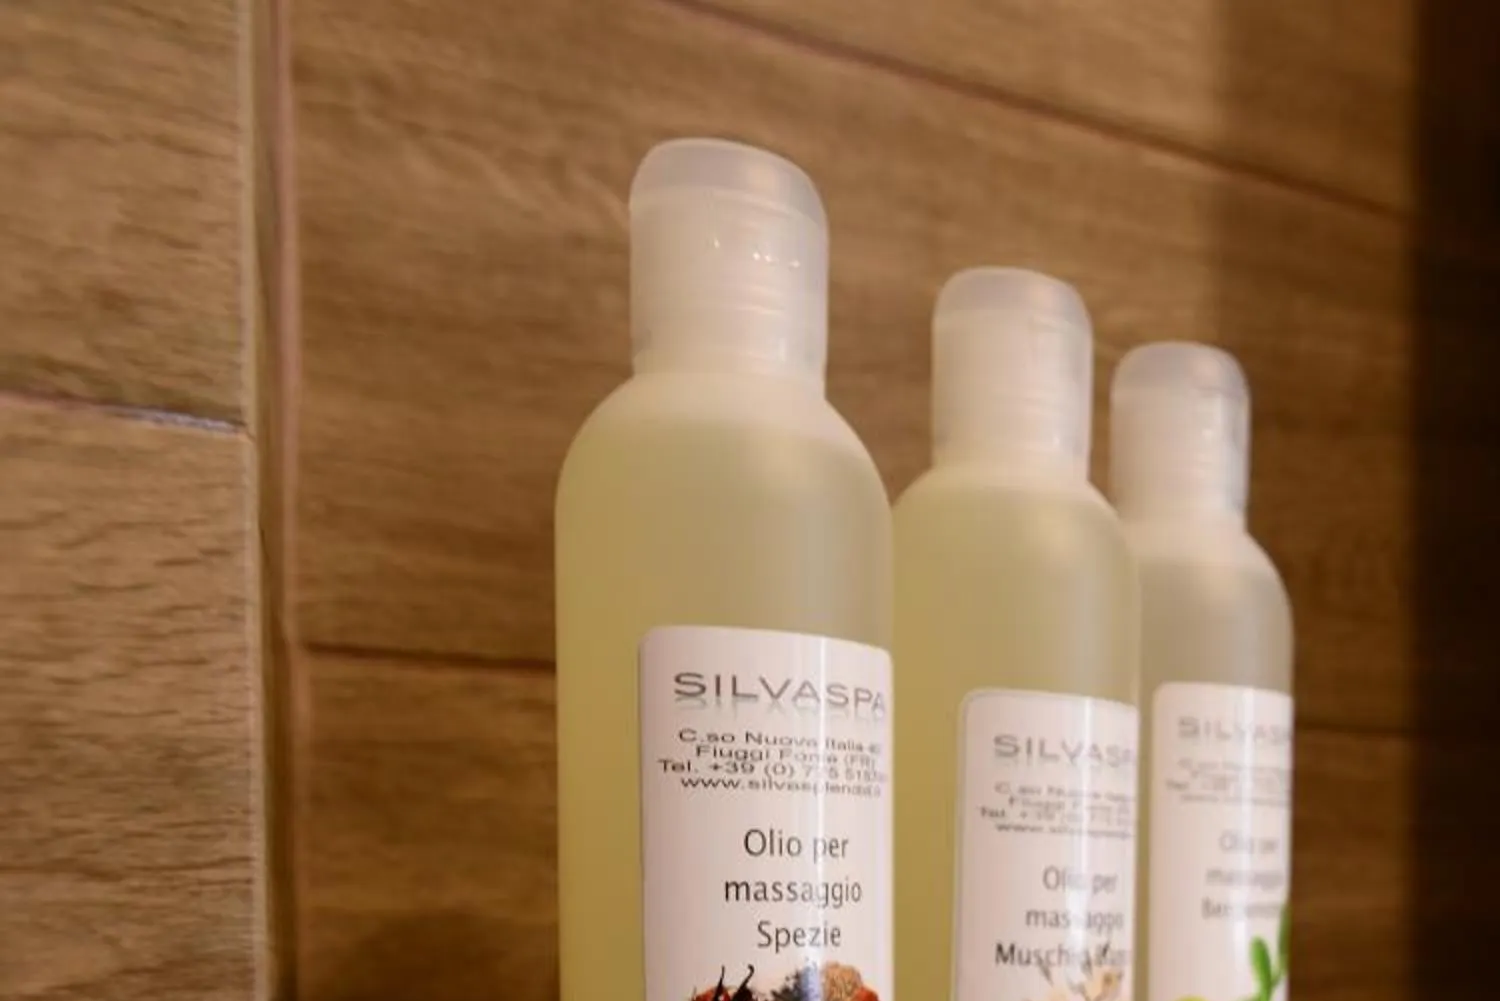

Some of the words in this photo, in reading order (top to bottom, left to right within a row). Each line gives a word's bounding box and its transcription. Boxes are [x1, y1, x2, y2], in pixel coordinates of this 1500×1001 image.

[674, 672, 885, 712] SILVASPA
[696, 745, 769, 762] Fiuggi
[779, 748, 838, 763] Fone
[744, 731, 818, 748] Nuova
[658, 759, 699, 774] Tel.
[708, 760, 755, 774] +39
[764, 762, 795, 780] (0)
[743, 827, 802, 857] Olio
[812, 836, 849, 864] per
[724, 876, 862, 909] massaggio
[756, 919, 841, 953] Spezie
